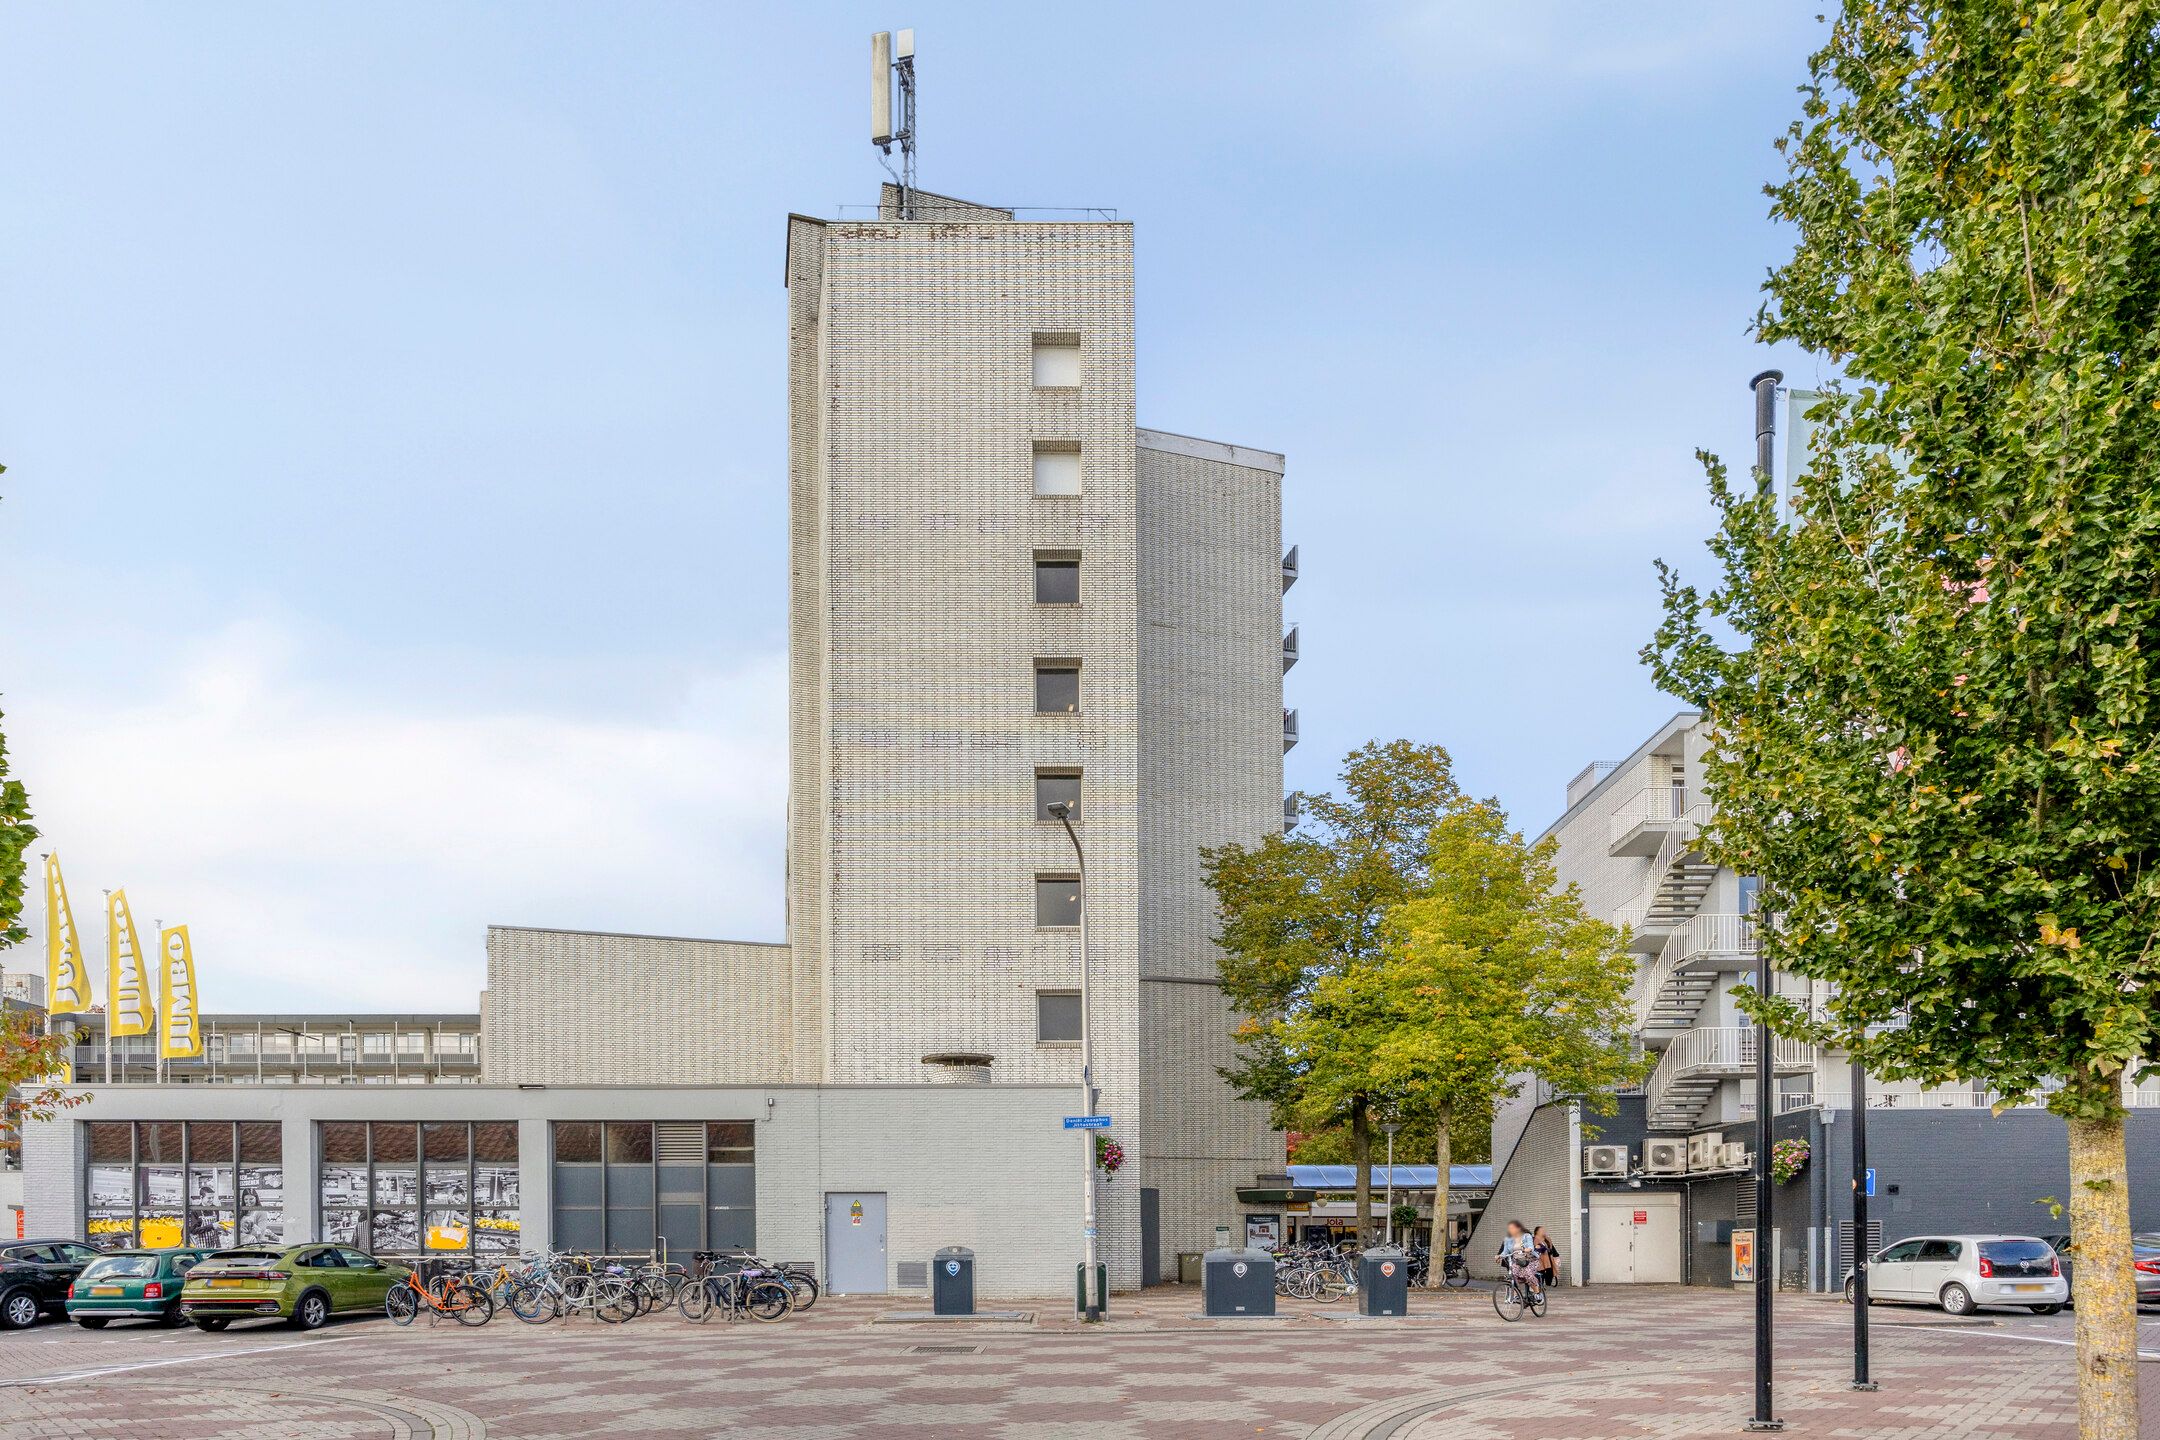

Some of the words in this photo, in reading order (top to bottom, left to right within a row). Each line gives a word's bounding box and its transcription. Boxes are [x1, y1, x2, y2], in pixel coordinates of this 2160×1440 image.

[114, 898, 145, 1029] JUMBO
[168, 932, 193, 1051] JUMBO
[1324, 1218, 1344, 1226] Jola
